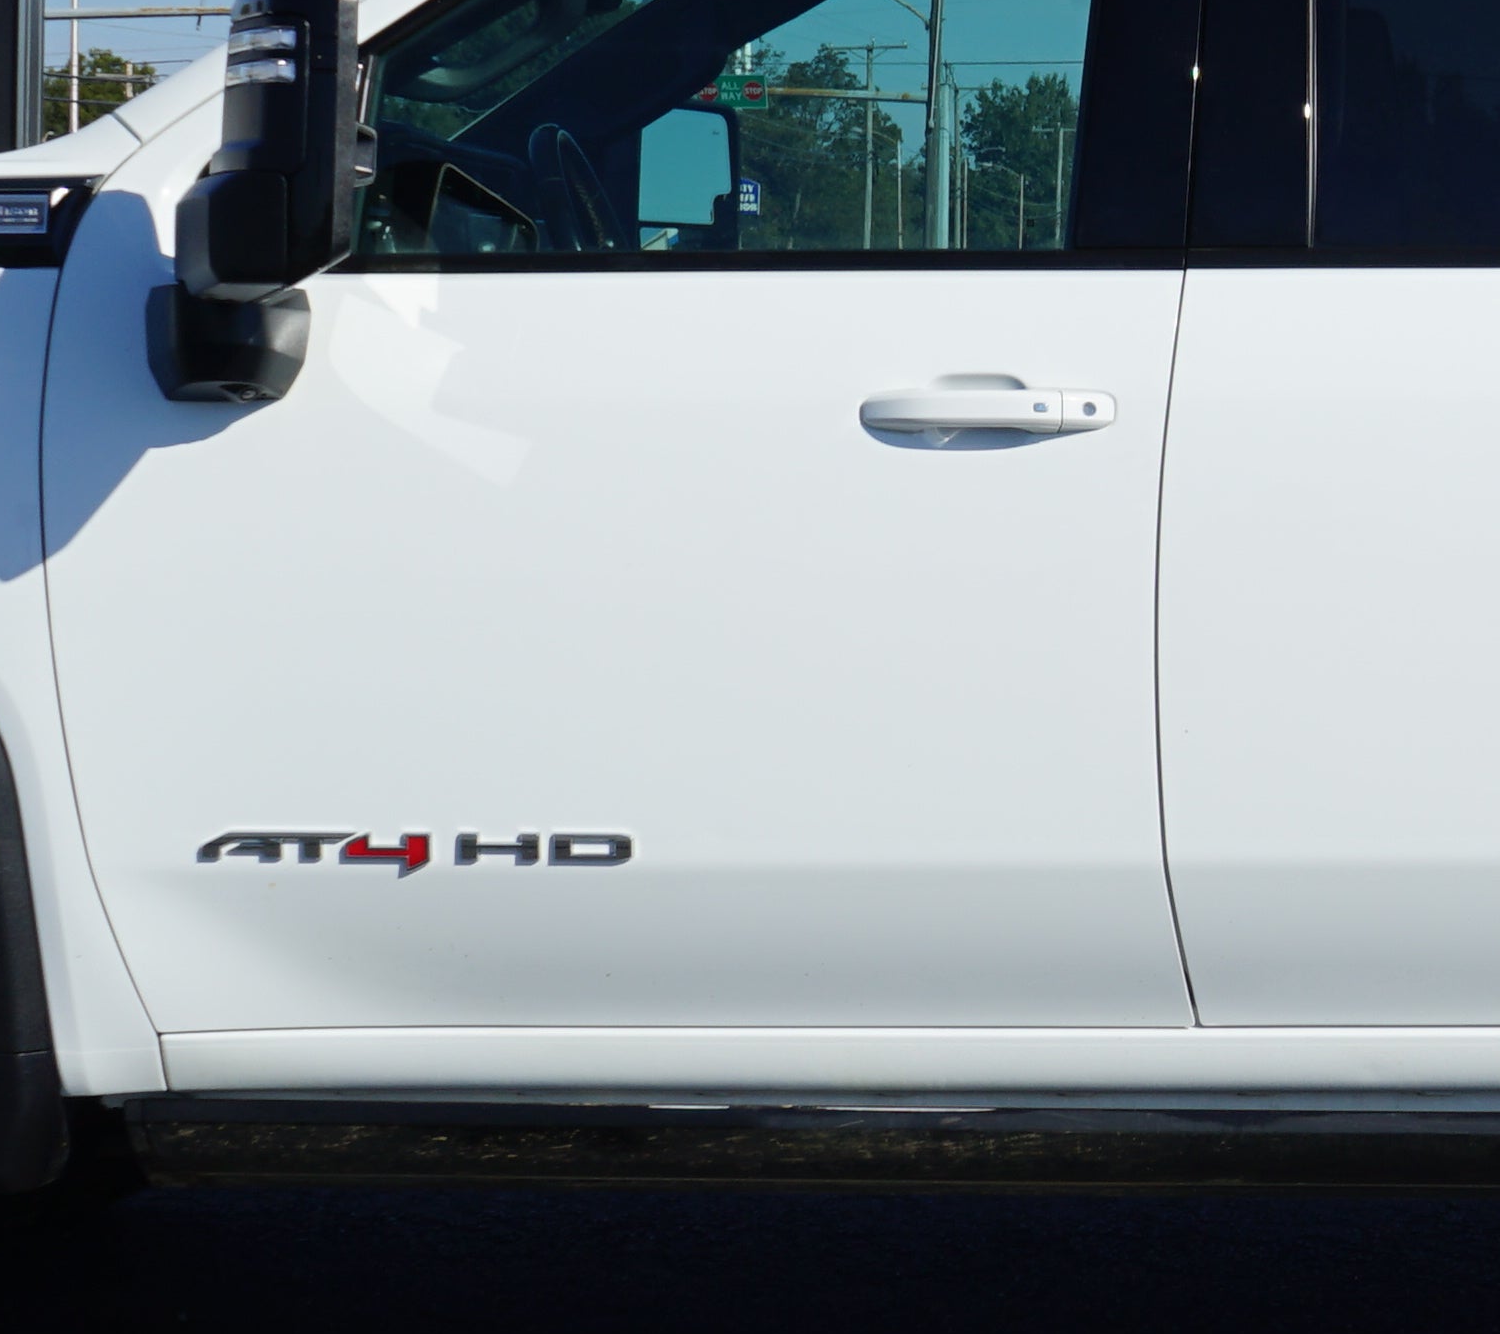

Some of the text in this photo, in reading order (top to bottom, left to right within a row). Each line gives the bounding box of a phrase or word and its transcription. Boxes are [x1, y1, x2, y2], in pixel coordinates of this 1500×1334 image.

[721, 82, 740, 90] ALL
[744, 87, 763, 95] STOP
[721, 92, 742, 101] WAY
[197, 830, 634, 877] AT4 HD
